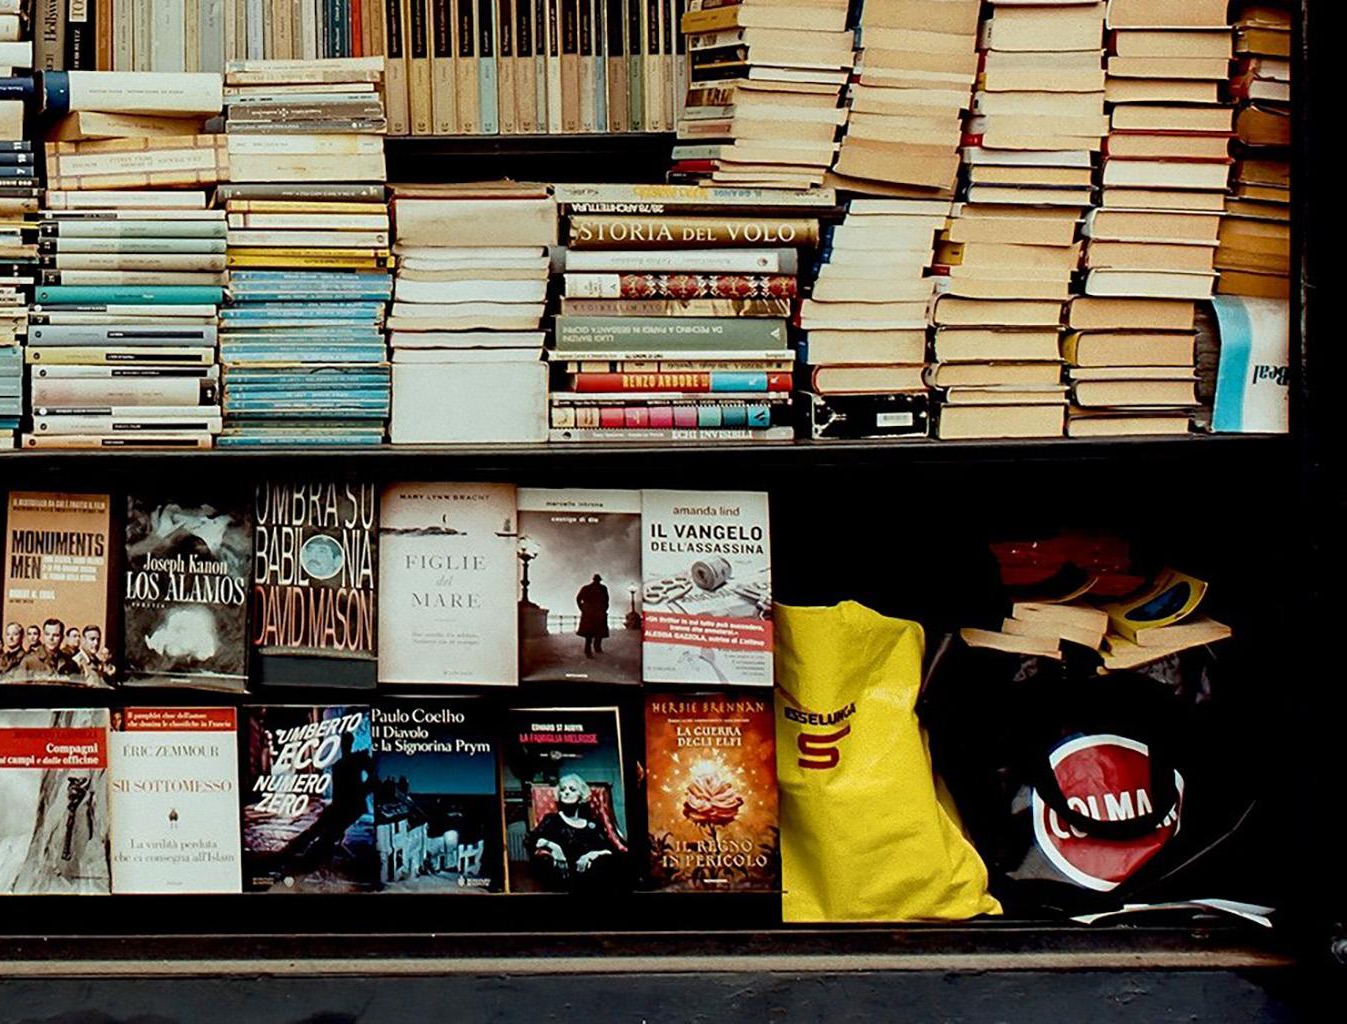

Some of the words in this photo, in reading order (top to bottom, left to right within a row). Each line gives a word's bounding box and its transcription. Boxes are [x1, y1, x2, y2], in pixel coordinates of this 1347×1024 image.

[579, 222, 674, 242] STORIA
[682, 227, 717, 241] DEL
[725, 223, 796, 243] VOLO
[622, 375, 656, 388] RENZO
[657, 375, 699, 388] ARBORE
[256, 482, 338, 527] OMBRA
[400, 493, 423, 501] MARY
[427, 494, 450, 502] LYNN
[672, 506, 717, 517] amanda
[719, 506, 740, 517] lind
[651, 524, 667, 539] IL
[674, 525, 763, 541] VANGELO
[12, 530, 105, 557] MONUMENTS
[651, 541, 764, 555] DELL'ASSASSINA
[10, 556, 41, 579] MEN
[143, 552, 185, 575] Joseph
[189, 554, 228, 575] Kanon
[405, 554, 487, 571] FIGLIE
[125, 570, 160, 601] LOS
[164, 575, 245, 606] ALAMOS
[412, 593, 481, 609] MARE
[254, 586, 303, 648] DAVID
[308, 587, 374, 651] MASON
[652, 701, 699, 714] HERBIE
[703, 701, 765, 714] BRENNAN
[371, 708, 410, 723] Paulo
[411, 708, 465, 724] Coelho
[276, 712, 363, 746] UMBERTO
[383, 726, 429, 739] Diavolo
[676, 726, 691, 737] LA
[694, 726, 742, 737] GUERRA
[46, 742, 99, 755] Compagni
[381, 740, 393, 752] la
[395, 739, 453, 756] Signorina
[456, 740, 491, 756] Prym
[677, 737, 711, 747] DEGLI
[714, 737, 742, 748] ELFI
[154, 744, 220, 758] ZEMMOUR
[271, 734, 342, 775] ECO
[133, 779, 233, 793] SOTTOMESSO
[252, 773, 333, 794] NUMERO
[253, 793, 310, 818] ZERO
[674, 839, 691, 854] IL
[696, 839, 753, 854] REGNO
[662, 854, 682, 868] IN
[685, 853, 768, 868] PERICOLO
